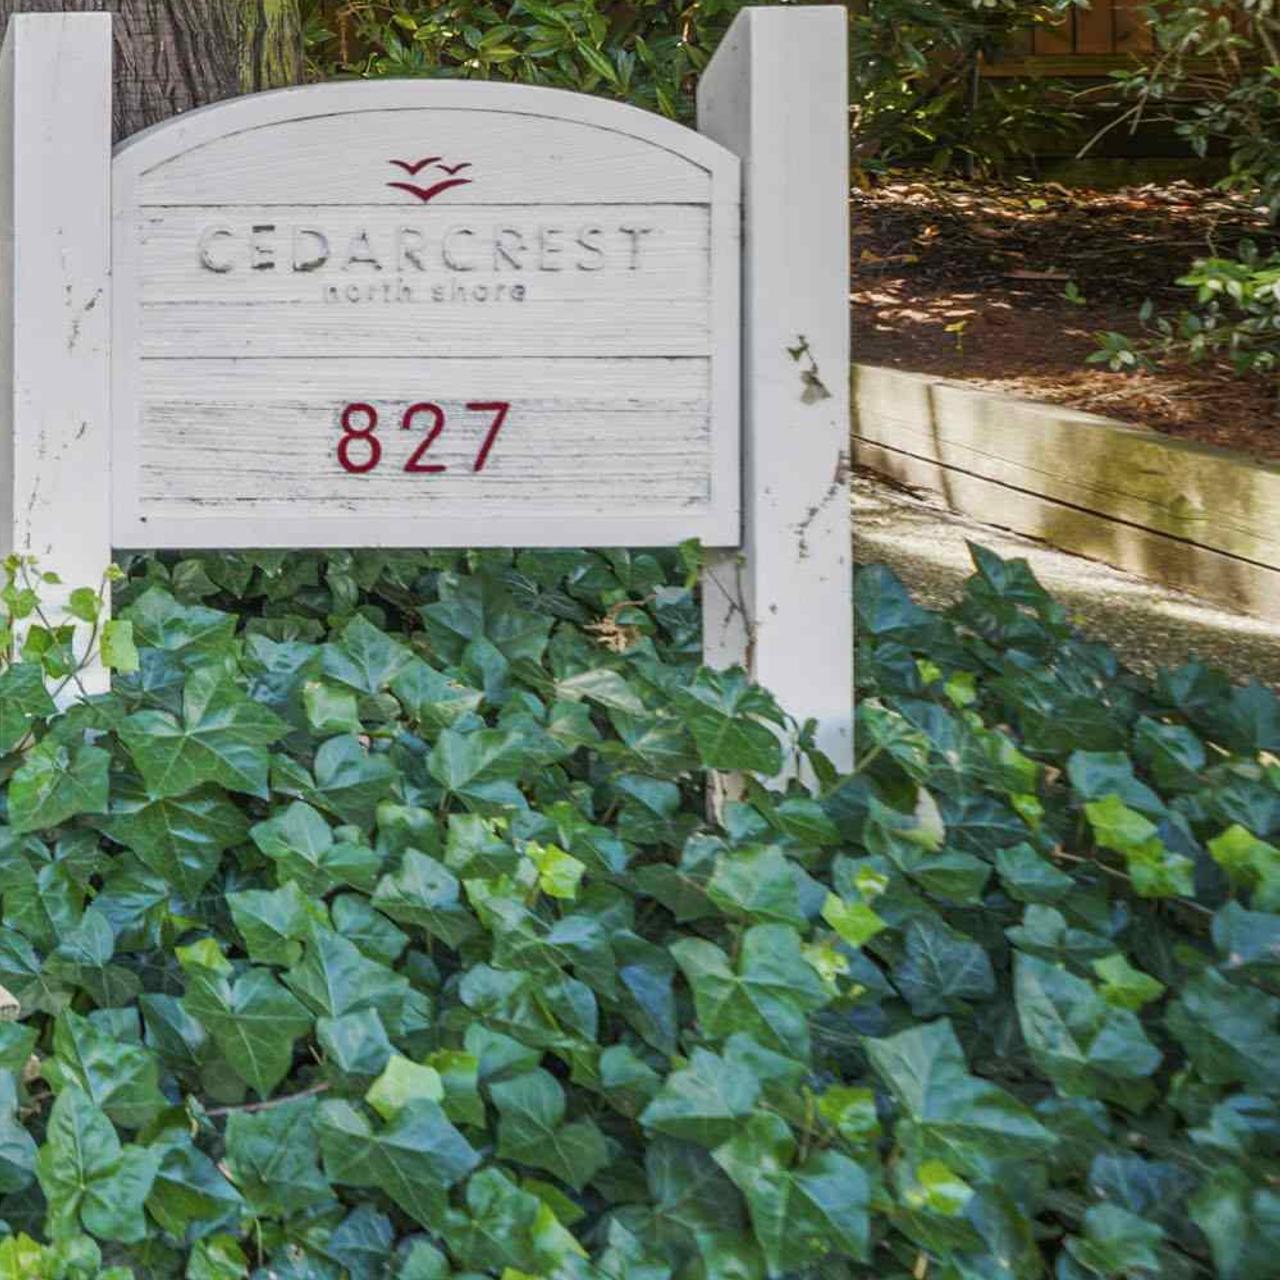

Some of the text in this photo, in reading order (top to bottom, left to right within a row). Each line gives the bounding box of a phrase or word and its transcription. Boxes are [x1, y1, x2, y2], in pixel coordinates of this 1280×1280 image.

[199, 224, 651, 273] CEDARCREST
[323, 278, 527, 303] north shore
[337, 402, 510, 474] 827
